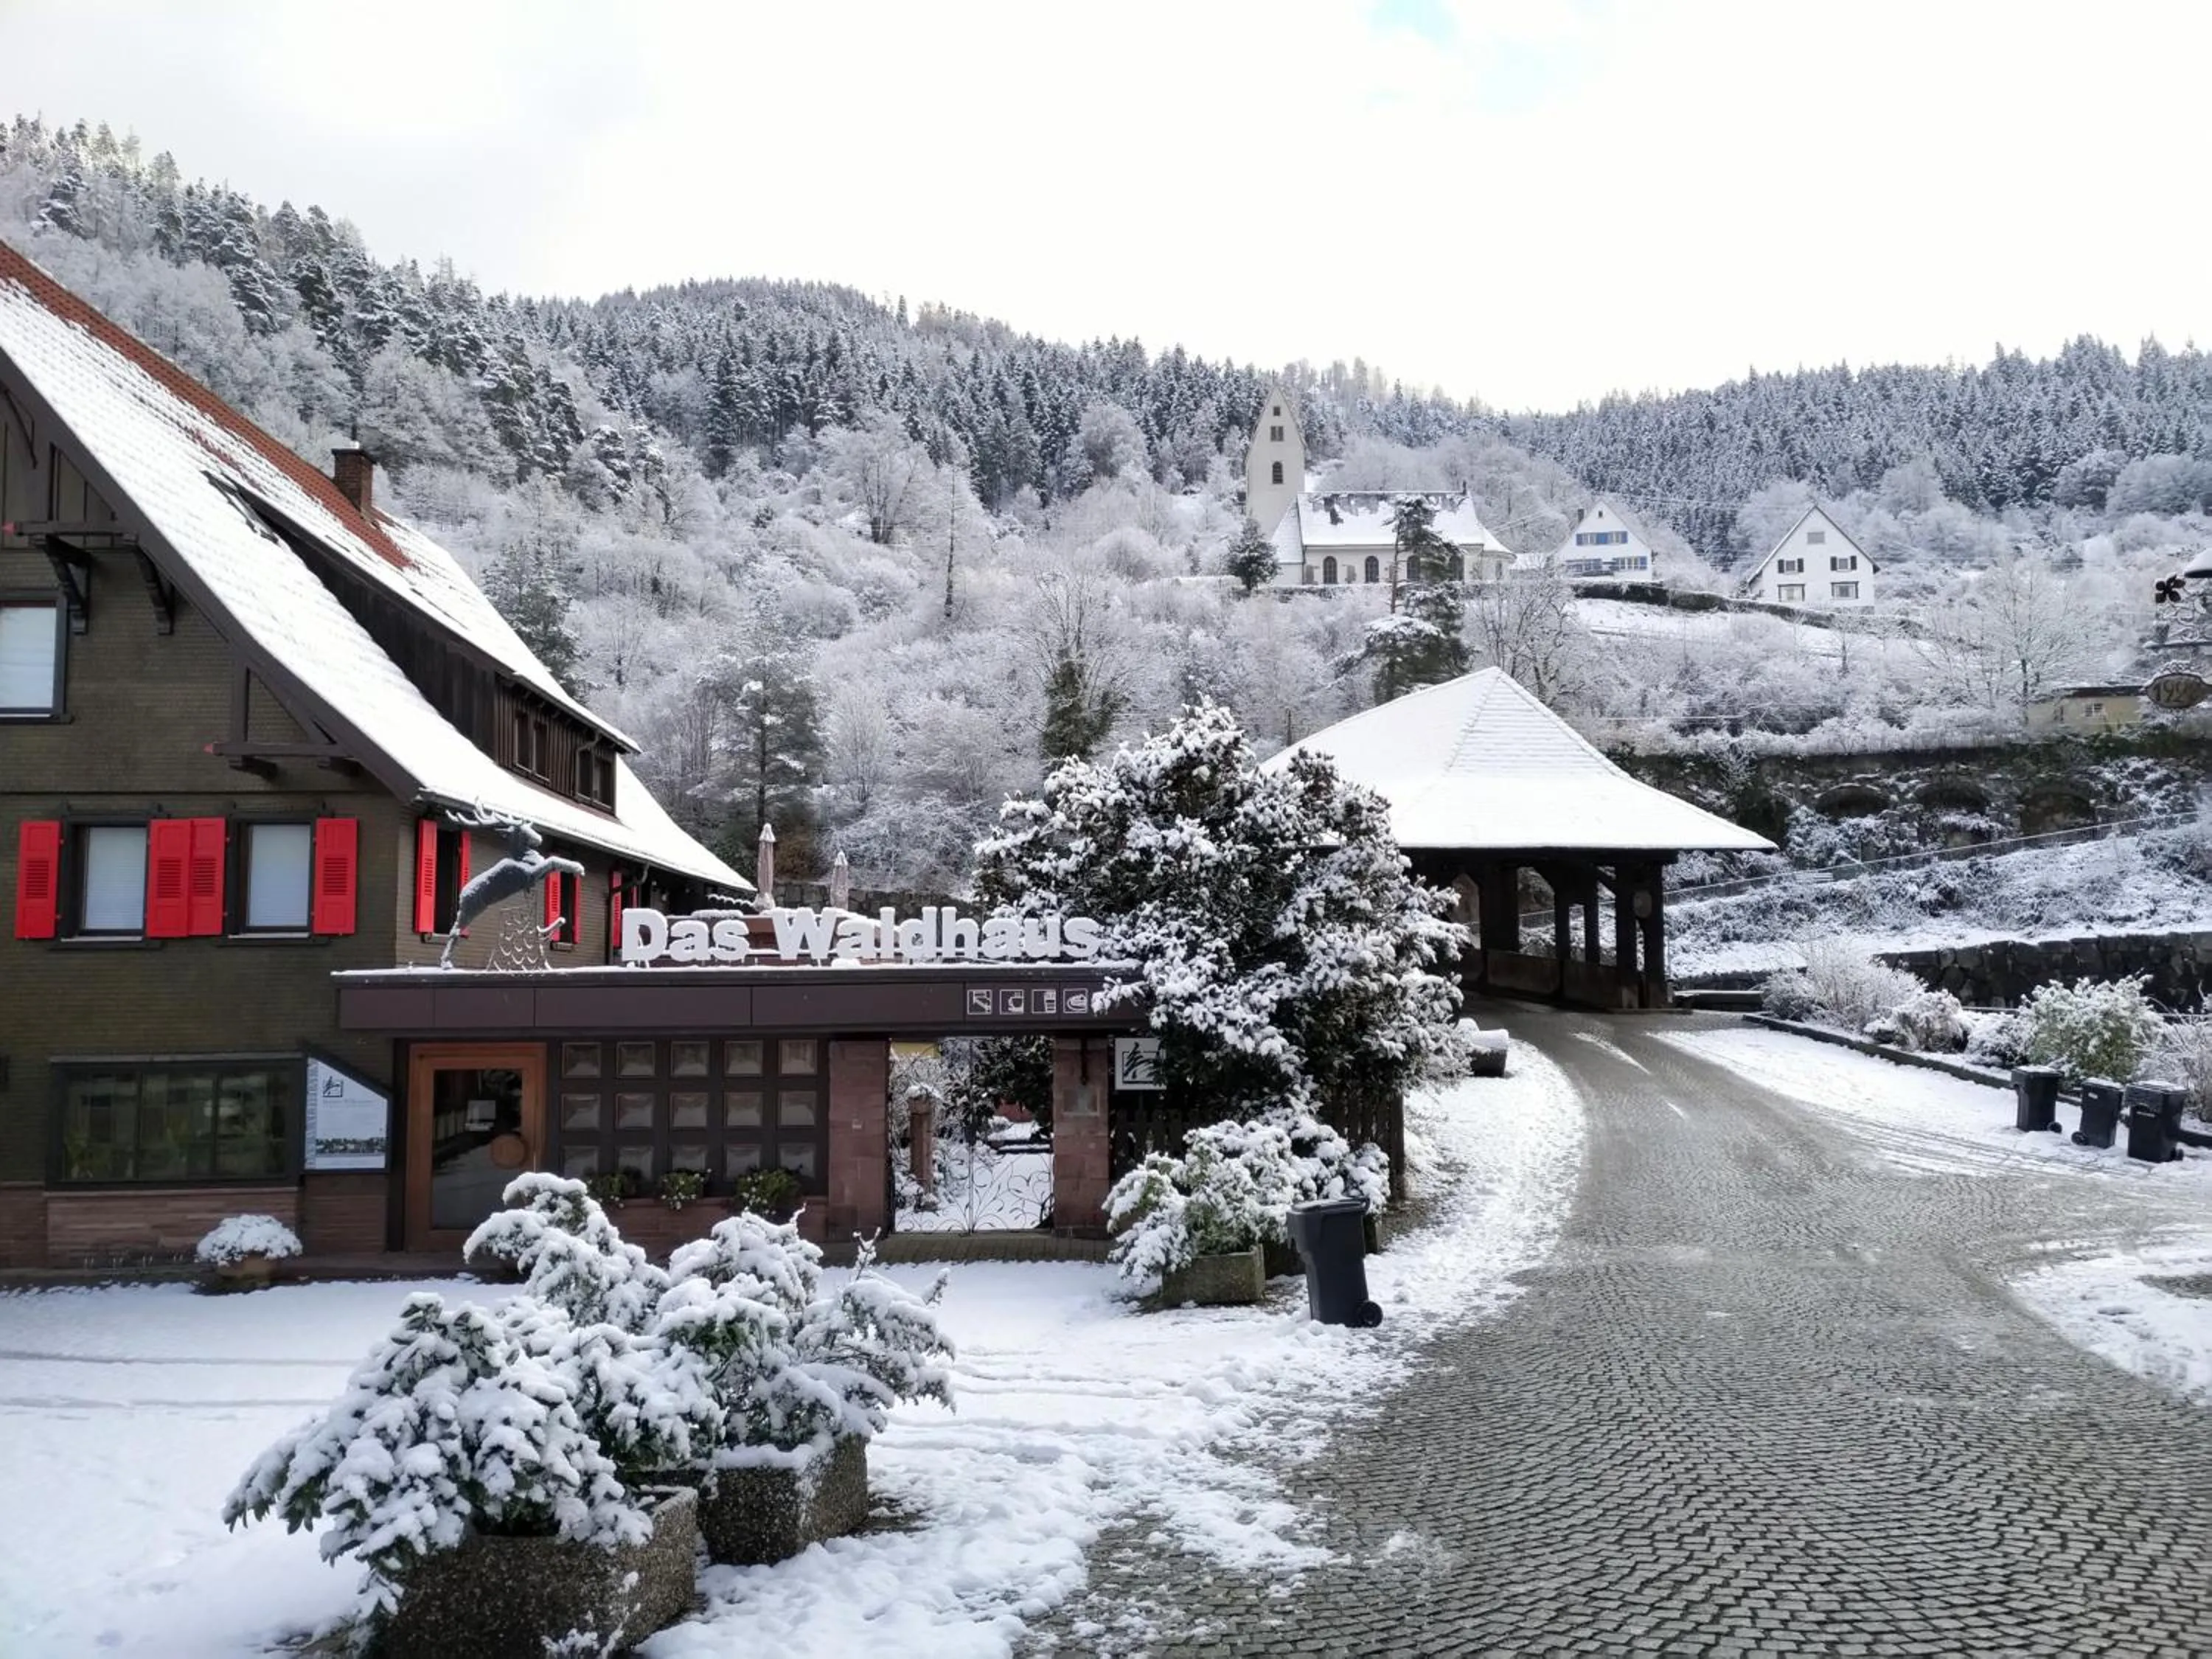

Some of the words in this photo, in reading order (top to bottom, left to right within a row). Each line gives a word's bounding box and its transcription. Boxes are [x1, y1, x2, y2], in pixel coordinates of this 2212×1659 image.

[2153, 680, 2200, 703] 192
[622, 908, 749, 961] Das
[771, 906, 1104, 959] Waldhaus
